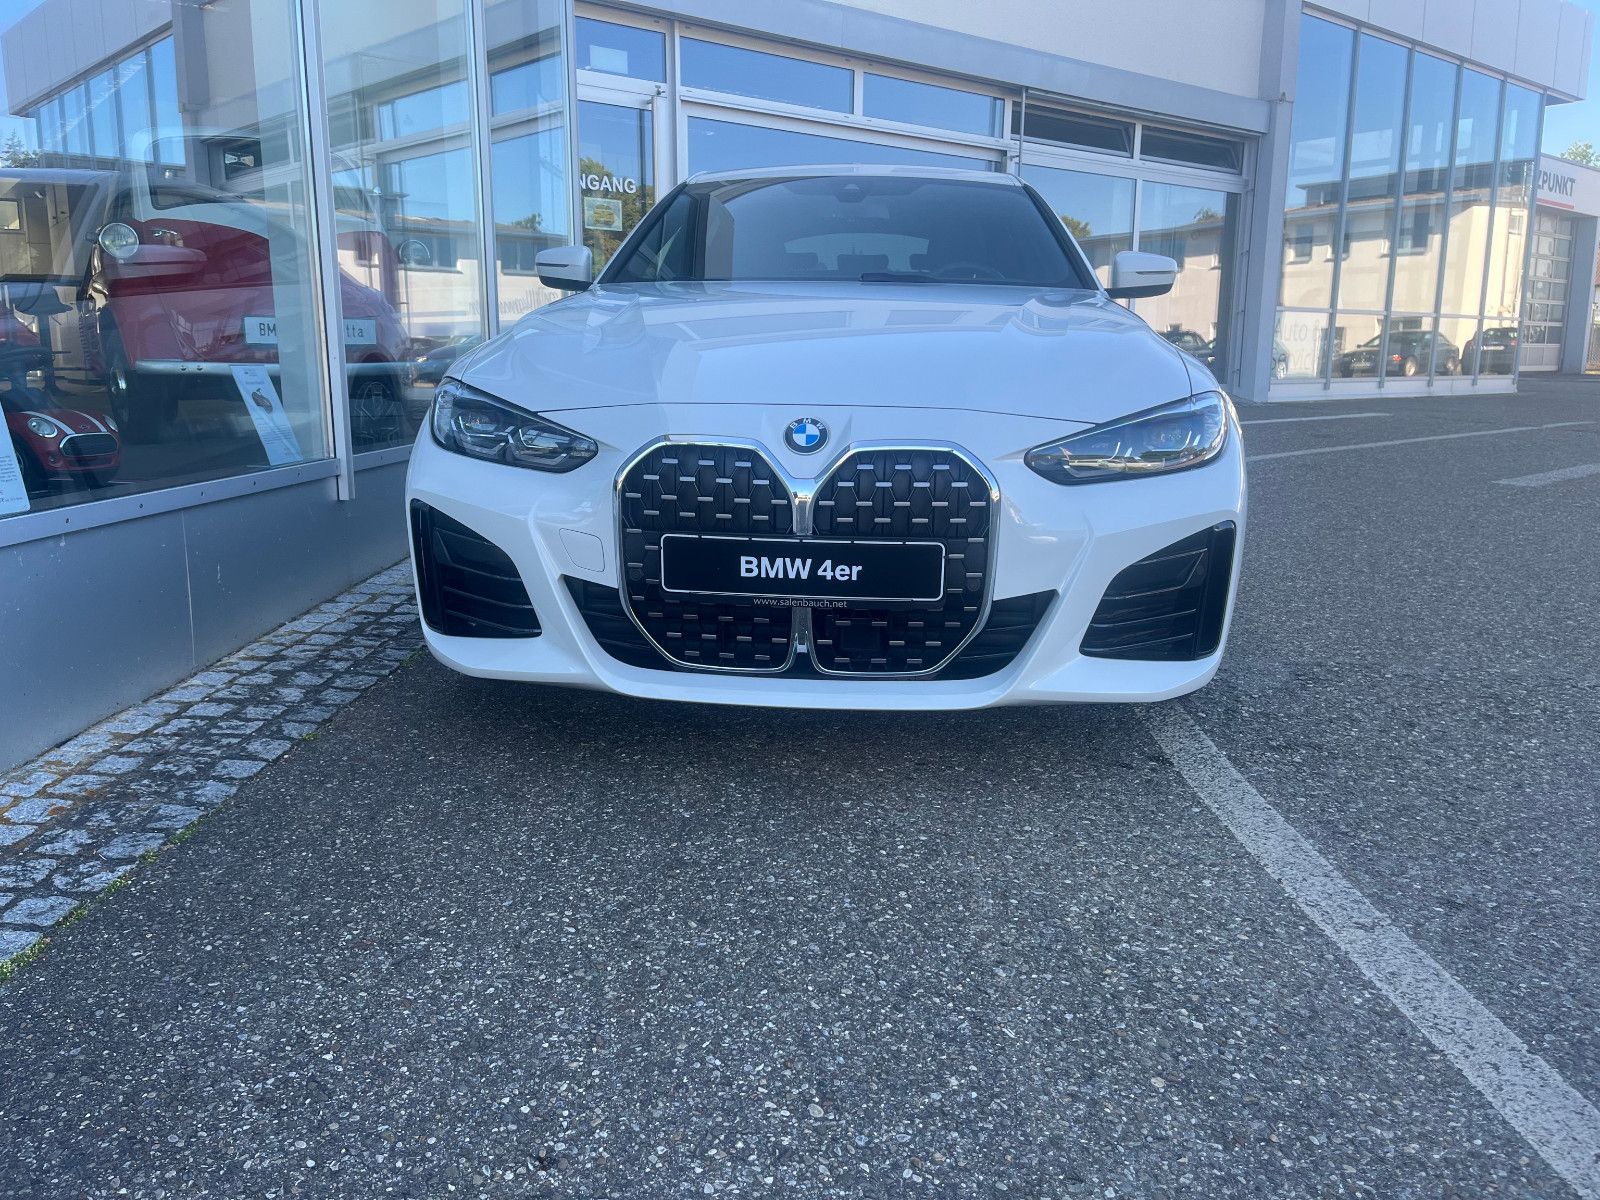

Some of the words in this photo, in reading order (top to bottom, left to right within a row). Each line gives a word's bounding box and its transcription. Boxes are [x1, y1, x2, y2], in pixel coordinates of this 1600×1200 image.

[789, 417, 825, 430] BMW
[740, 555, 812, 580] BMW
[817, 559, 863, 581] 4er
[753, 598, 848, 608] www.salenbauch.net
